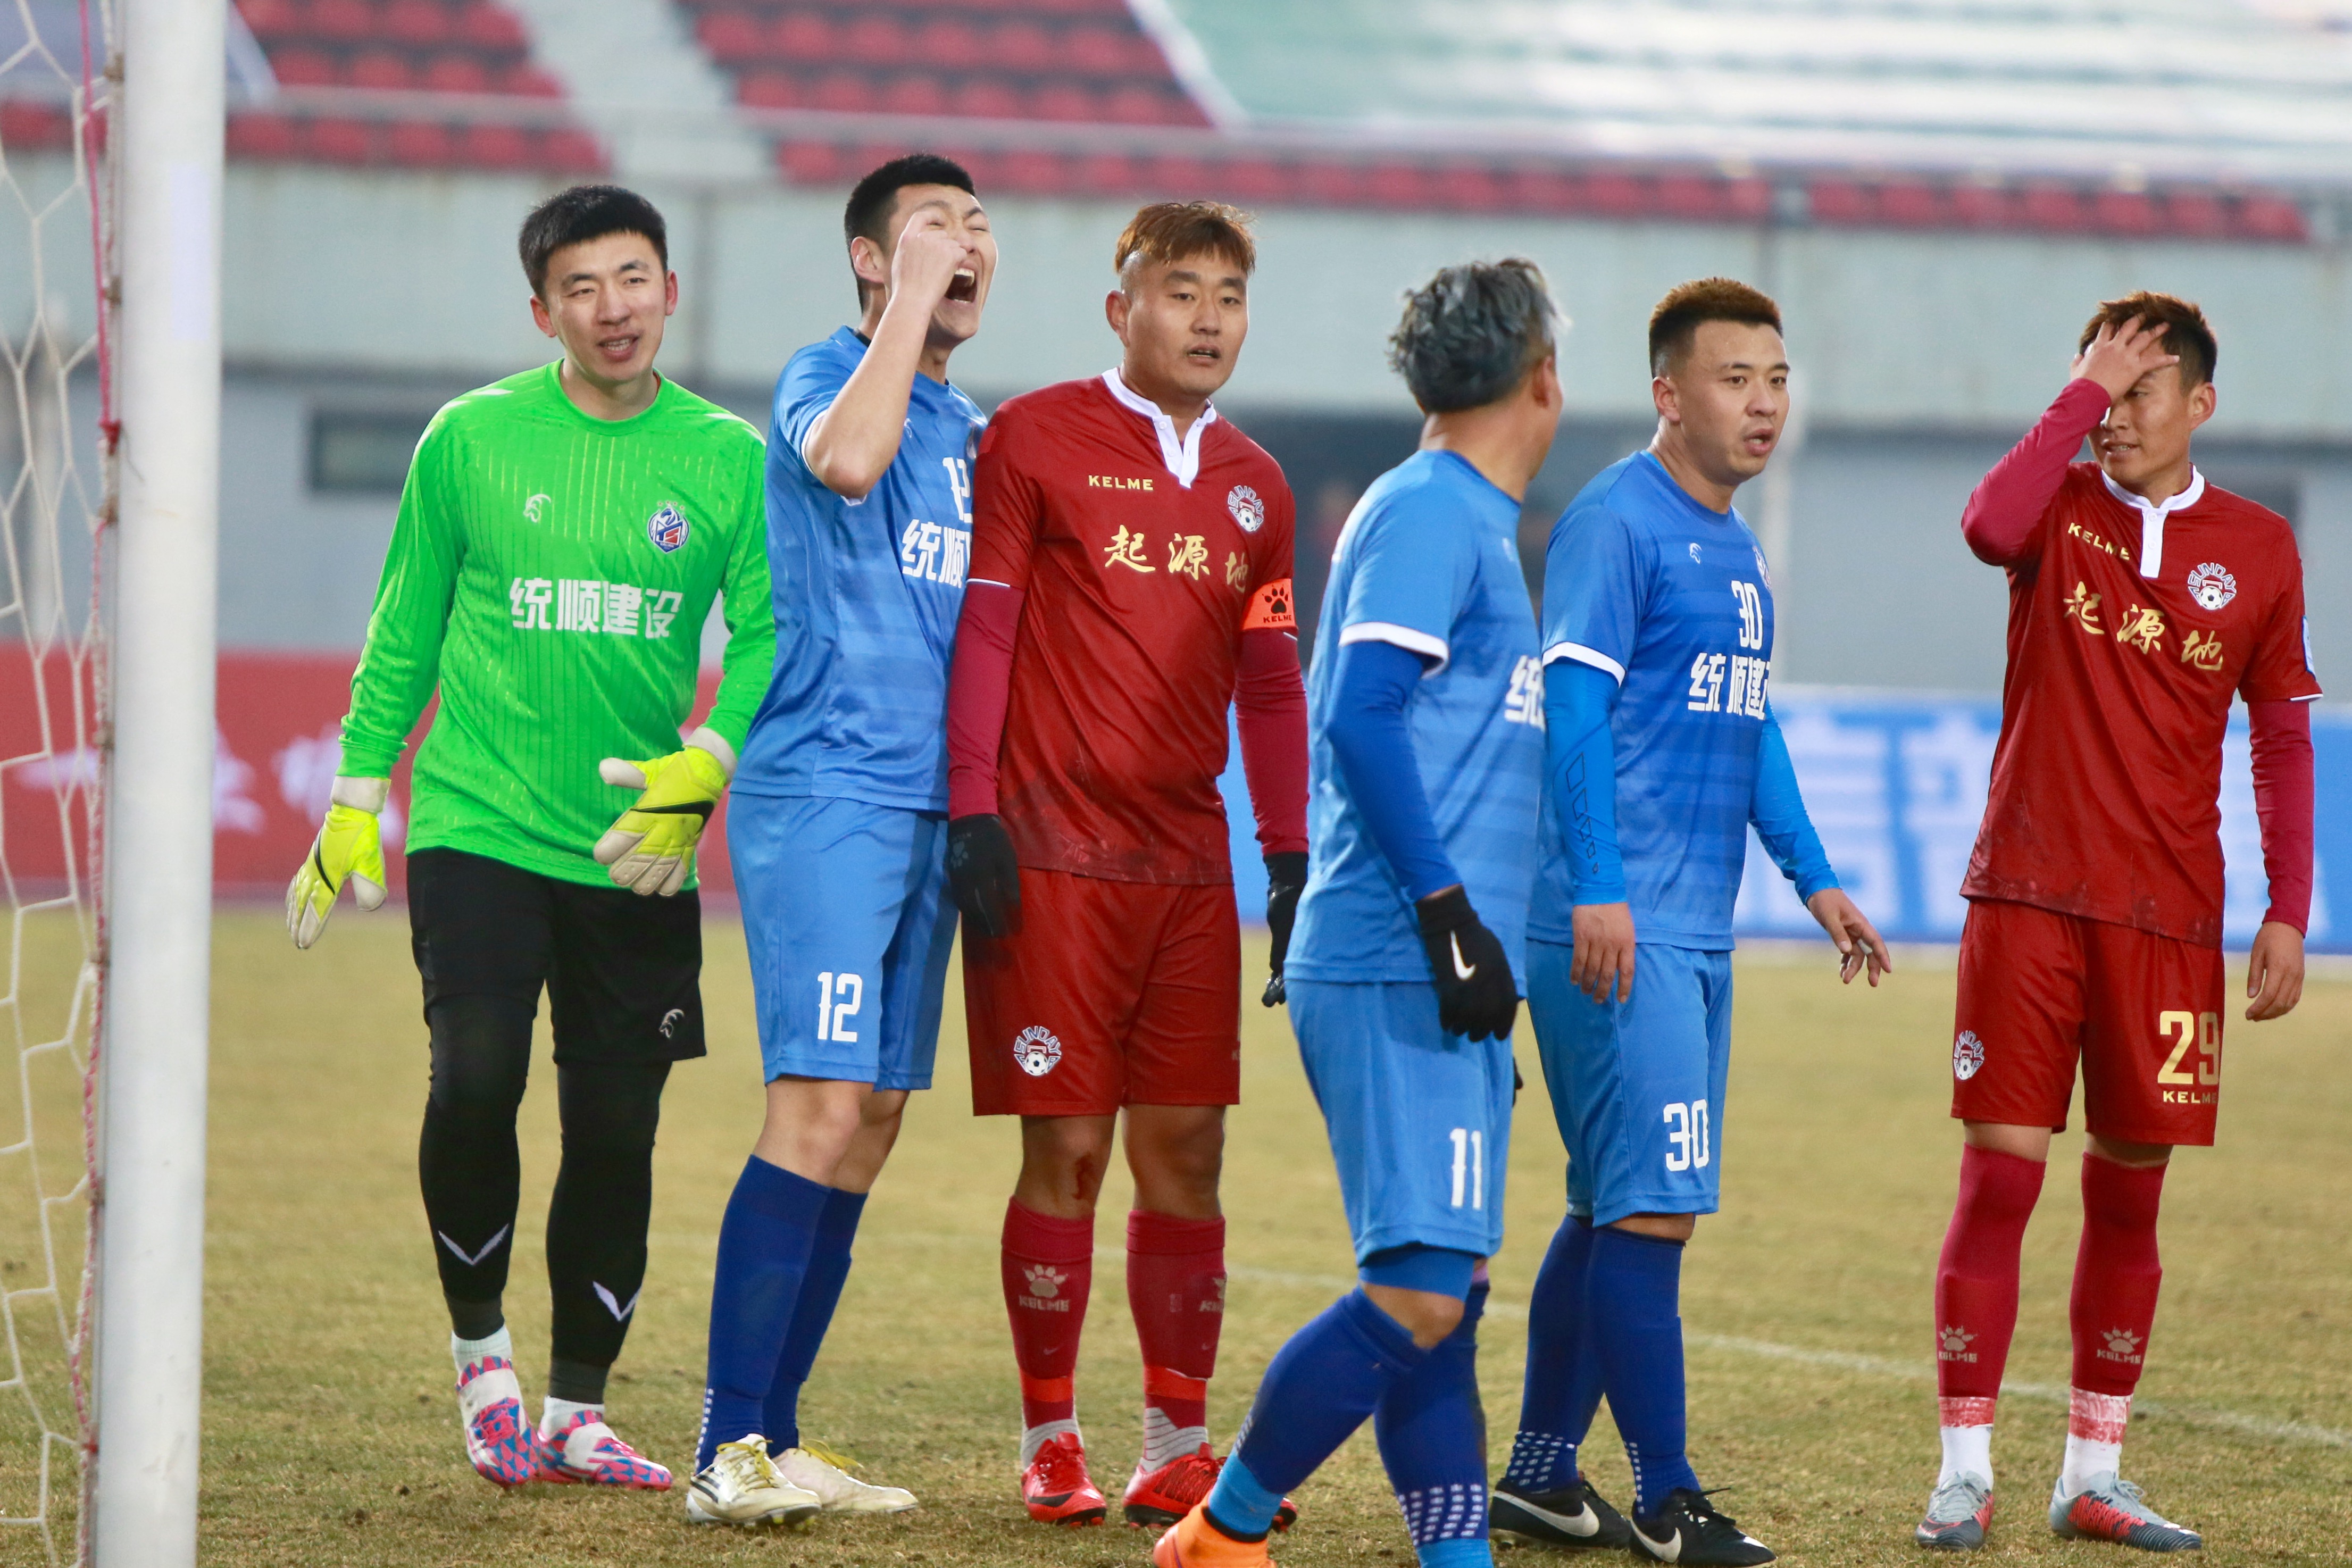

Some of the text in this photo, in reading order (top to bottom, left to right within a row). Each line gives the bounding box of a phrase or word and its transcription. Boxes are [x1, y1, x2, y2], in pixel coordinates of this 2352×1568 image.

[1088, 475, 1154, 491] KELME
[1228, 485, 1264, 519] SUNDAY
[902, 519, 973, 589] 统顺
[2068, 522, 2130, 560] KELME
[510, 577, 683, 639] 统顺建设
[2187, 562, 2237, 594] SUNDAY
[1731, 580, 1763, 650] 30
[2063, 581, 2223, 671] 起源地
[1688, 652, 1771, 721] 统顺建
[817, 972, 863, 1042] 12
[1014, 1025, 1062, 1055] SUNDAY
[2157, 1010, 2220, 1086] 29
[2163, 1090, 2217, 1104] KELME
[1663, 1099, 1709, 1172] 30
[1449, 1128, 1482, 1210] 11
[1019, 1295, 1070, 1313] KELME
